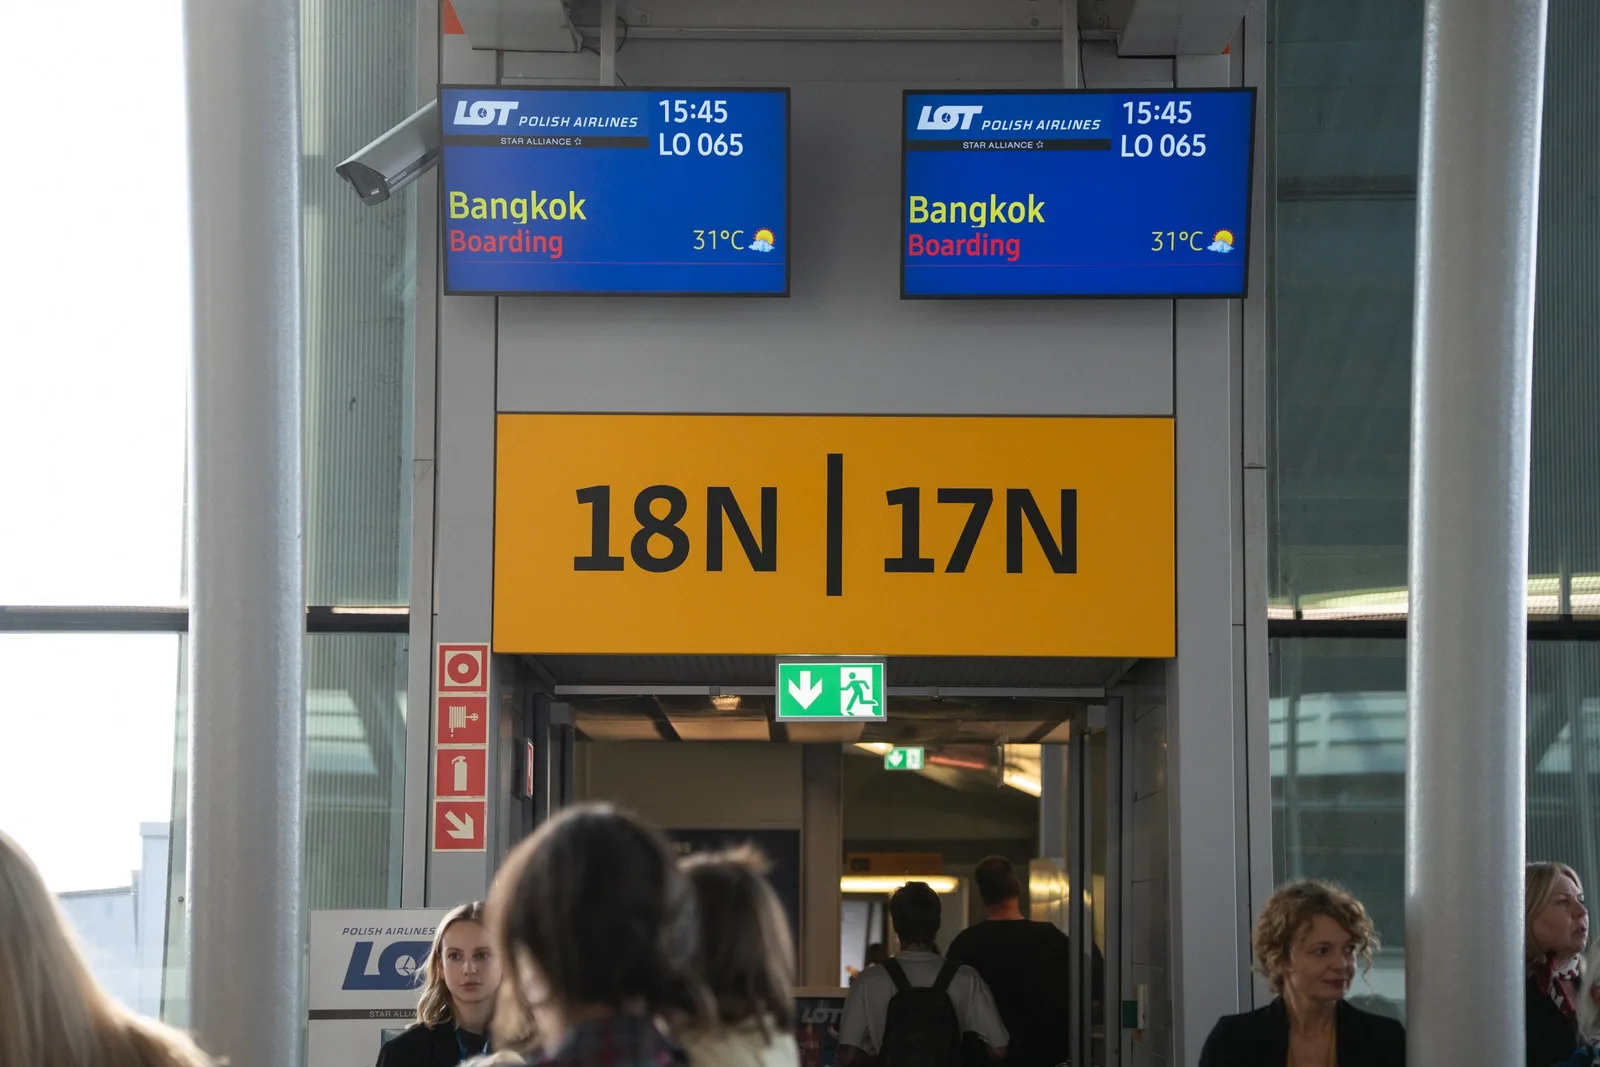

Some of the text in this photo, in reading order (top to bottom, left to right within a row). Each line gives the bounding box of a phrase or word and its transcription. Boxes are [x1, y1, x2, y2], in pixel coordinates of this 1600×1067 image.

[452, 100, 639, 128] LOT POLISH AIRLINES
[659, 99, 728, 124] 15:45
[916, 105, 1102, 131] LOT POLISH AIRLINES
[1122, 100, 1192, 125] 15:45
[500, 136, 572, 147] STAR ALLIANCE
[659, 132, 744, 157] LO 065
[962, 140, 1034, 150] STAR ALLIANCE
[1121, 133, 1206, 158] LO 065
[449, 190, 587, 225] Bangkok
[908, 193, 1046, 228] Bangkok
[450, 229, 563, 259] Boarding
[693, 229, 744, 251] 31°C
[908, 232, 1021, 262] Boarding
[1151, 231, 1203, 252] 31°C
[573, 484, 1078, 575] 18N 17N
[342, 926, 436, 936] POLISH AIRLINES
[341, 940, 435, 990] LO
[369, 1010, 417, 1019] STAR ALLIA
